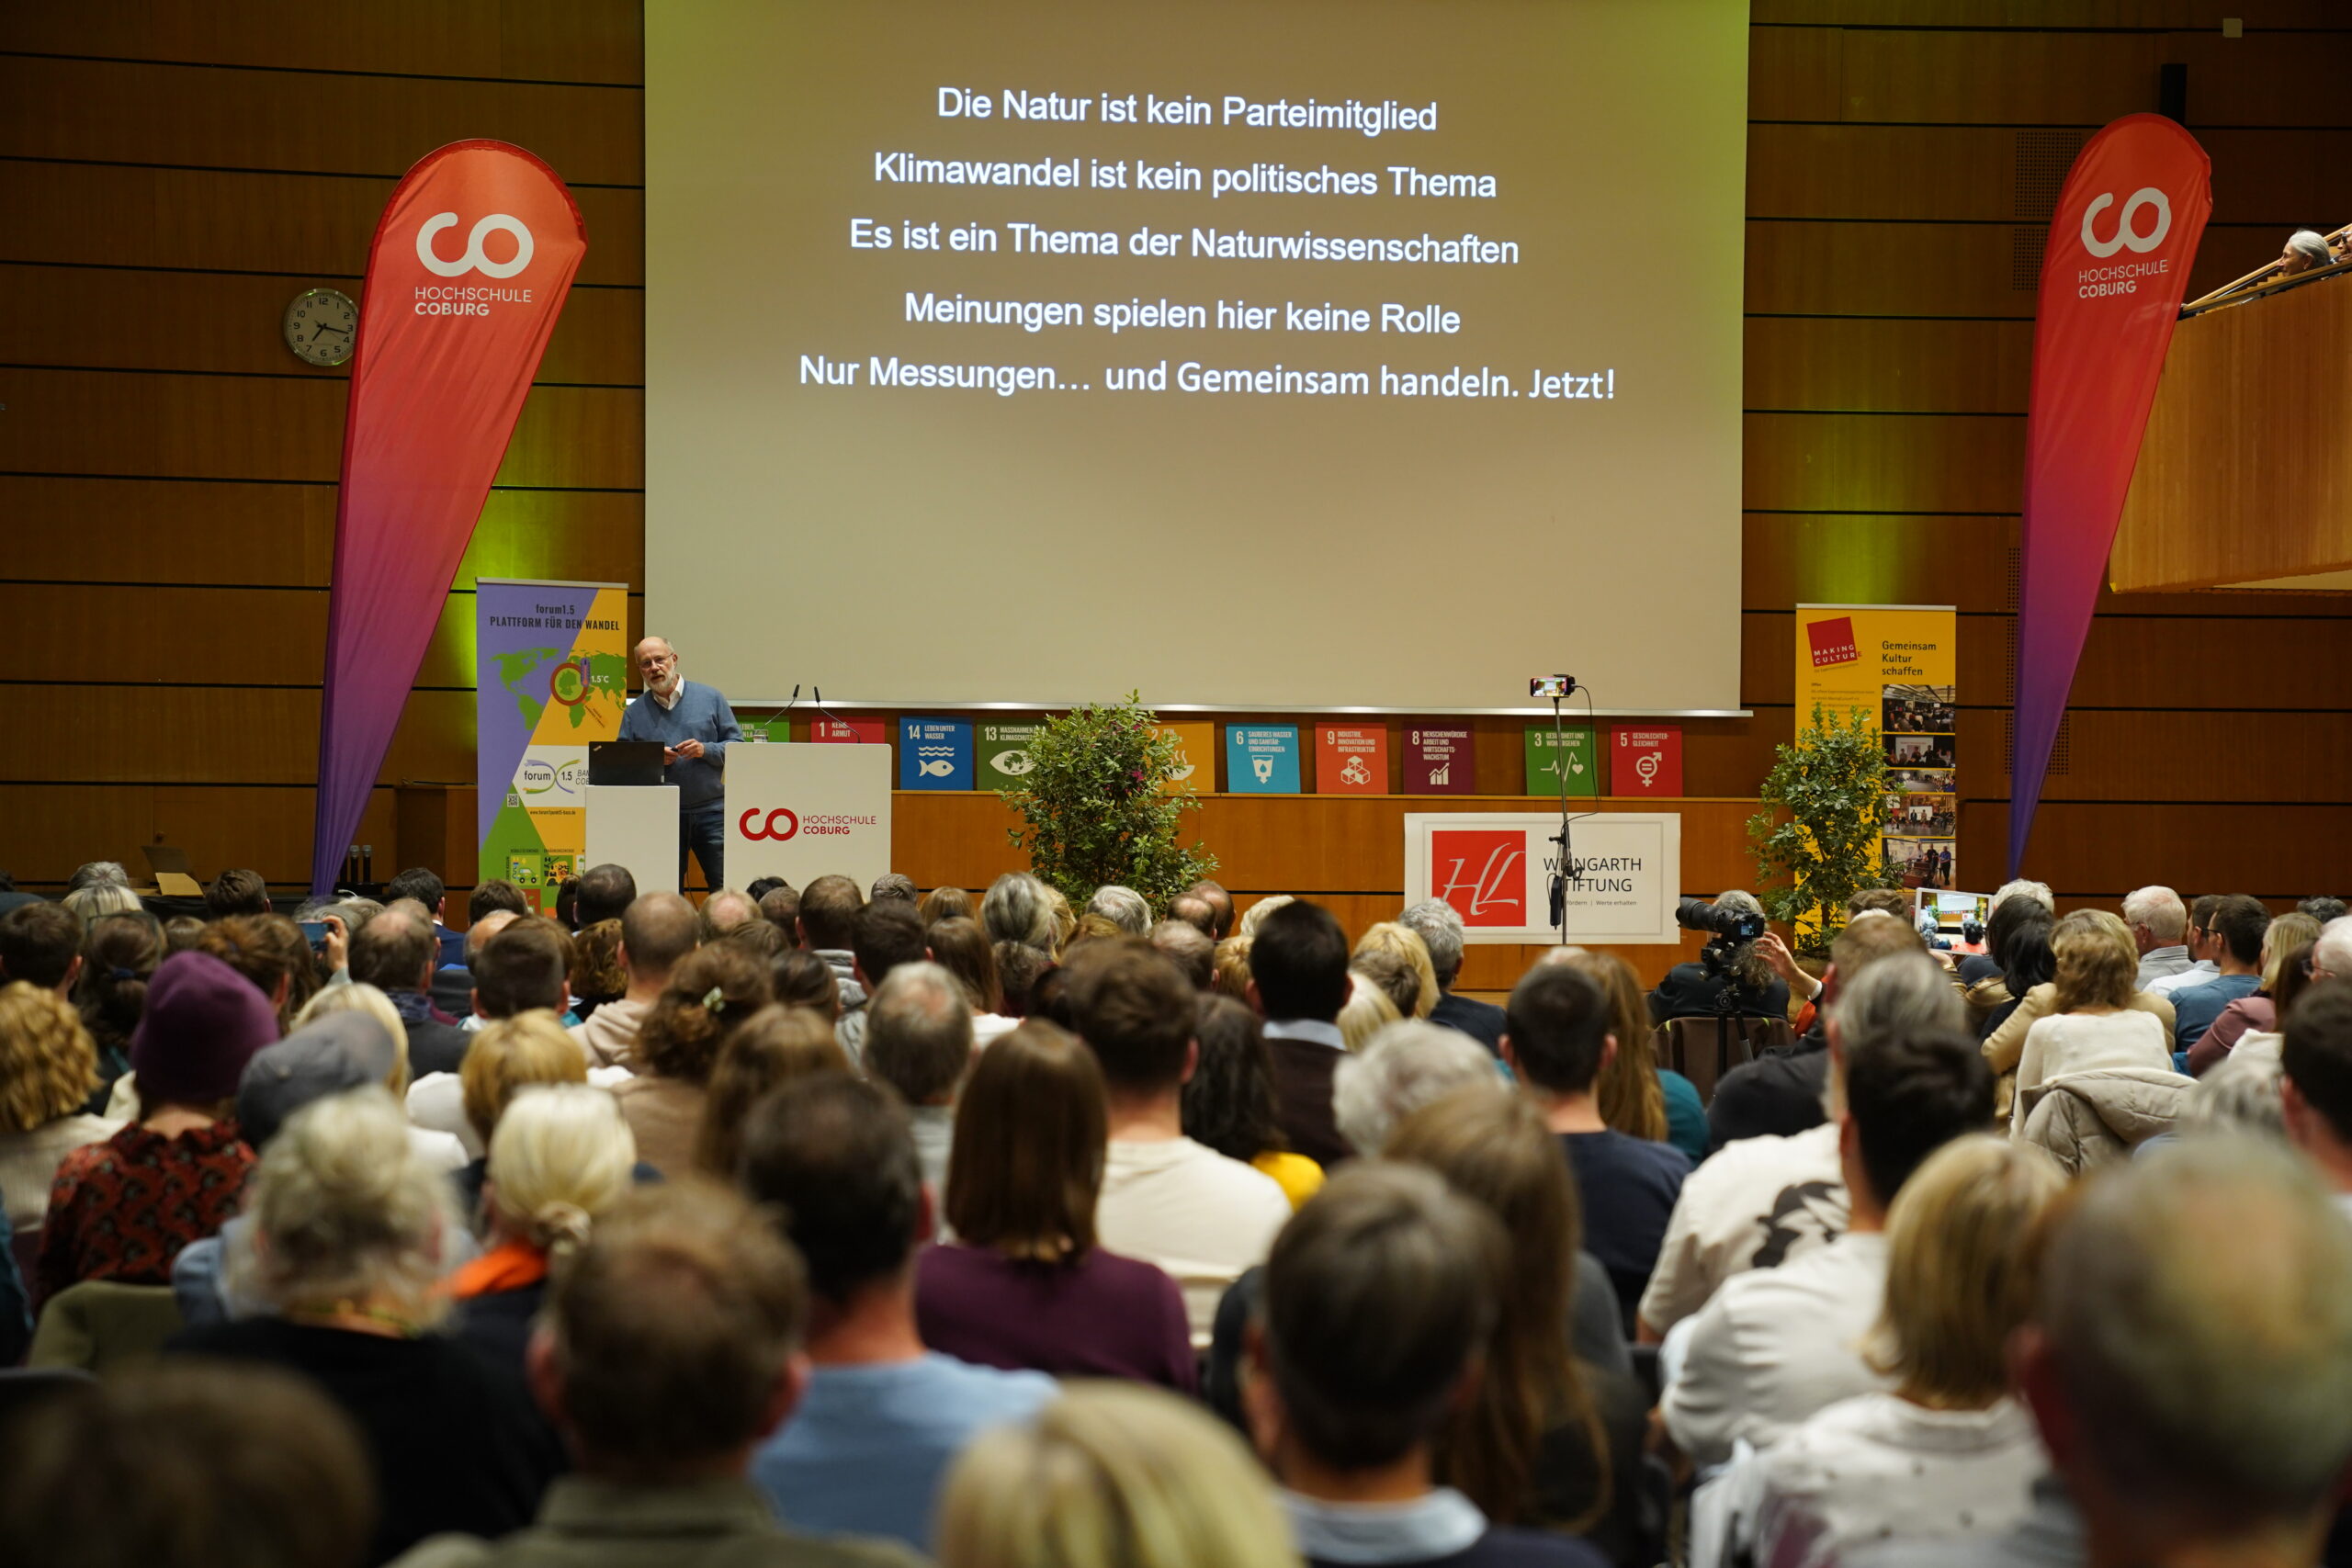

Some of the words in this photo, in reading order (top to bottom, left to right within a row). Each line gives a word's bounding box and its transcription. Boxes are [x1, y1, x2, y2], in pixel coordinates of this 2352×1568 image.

[938, 86, 992, 118] Die
[1003, 89, 1092, 121] Natur
[1101, 92, 1137, 123] ist
[1147, 94, 1212, 125] kein
[1223, 96, 1437, 137] Parteimitglied
[875, 152, 1080, 187] Klimawandel
[1091, 158, 1127, 189] ist
[1136, 160, 1202, 191] kein
[1213, 163, 1378, 198] politisches
[1386, 166, 1497, 197] Thema
[851, 218, 893, 249] Es
[903, 220, 940, 251] ist
[948, 221, 997, 252] ein
[1006, 222, 1119, 255] Thema
[1128, 226, 1183, 257] der
[1192, 228, 1519, 264] Naturwissenschaften
[2078, 259, 2169, 283] HOCHSCHULE
[415, 287, 532, 302] HOCHSCHULE
[2078, 280, 2137, 299] COBURG
[415, 302, 490, 316] COBURG
[905, 292, 1083, 333] Meinungen
[1093, 298, 1206, 334] spielen
[1217, 299, 1278, 330] hier
[1286, 301, 1371, 333] keine
[1381, 303, 1461, 334] Rolle
[800, 355, 861, 386] Nur
[1105, 359, 1167, 391] und
[1177, 361, 1369, 395] Gemeinsam
[1380, 364, 1519, 398] handeln.
[1528, 368, 1614, 400] Jetzt!
[536, 604, 575, 615] forum1.5
[490, 616, 542, 628] PLATTFORM
[545, 616, 562, 628] FÜR
[565, 619, 582, 629] DEN
[585, 620, 620, 631] WANDEL
[1814, 644, 1855, 657] MAKING
[1882, 640, 1937, 650] Gemeinsam
[1815, 650, 1863, 664] CULTURE
[1882, 654, 1912, 663] Kultur
[1882, 667, 1923, 676] schaffen
[819, 722, 825, 737] 1
[831, 729, 851, 738] ARMUT
[908, 724, 921, 739] 14
[924, 732, 945, 740] WASSER
[985, 727, 997, 741] 13
[1236, 730, 1244, 745] 6
[1327, 730, 1335, 745] 9
[1412, 730, 1419, 745] 8
[1534, 732, 1542, 747] 3
[1620, 732, 1628, 747] 5
[524, 770, 551, 781] forum
[561, 772, 572, 781] 1.5
[803, 815, 876, 825] HOCHSCHULE
[803, 826, 851, 835] COBURG
